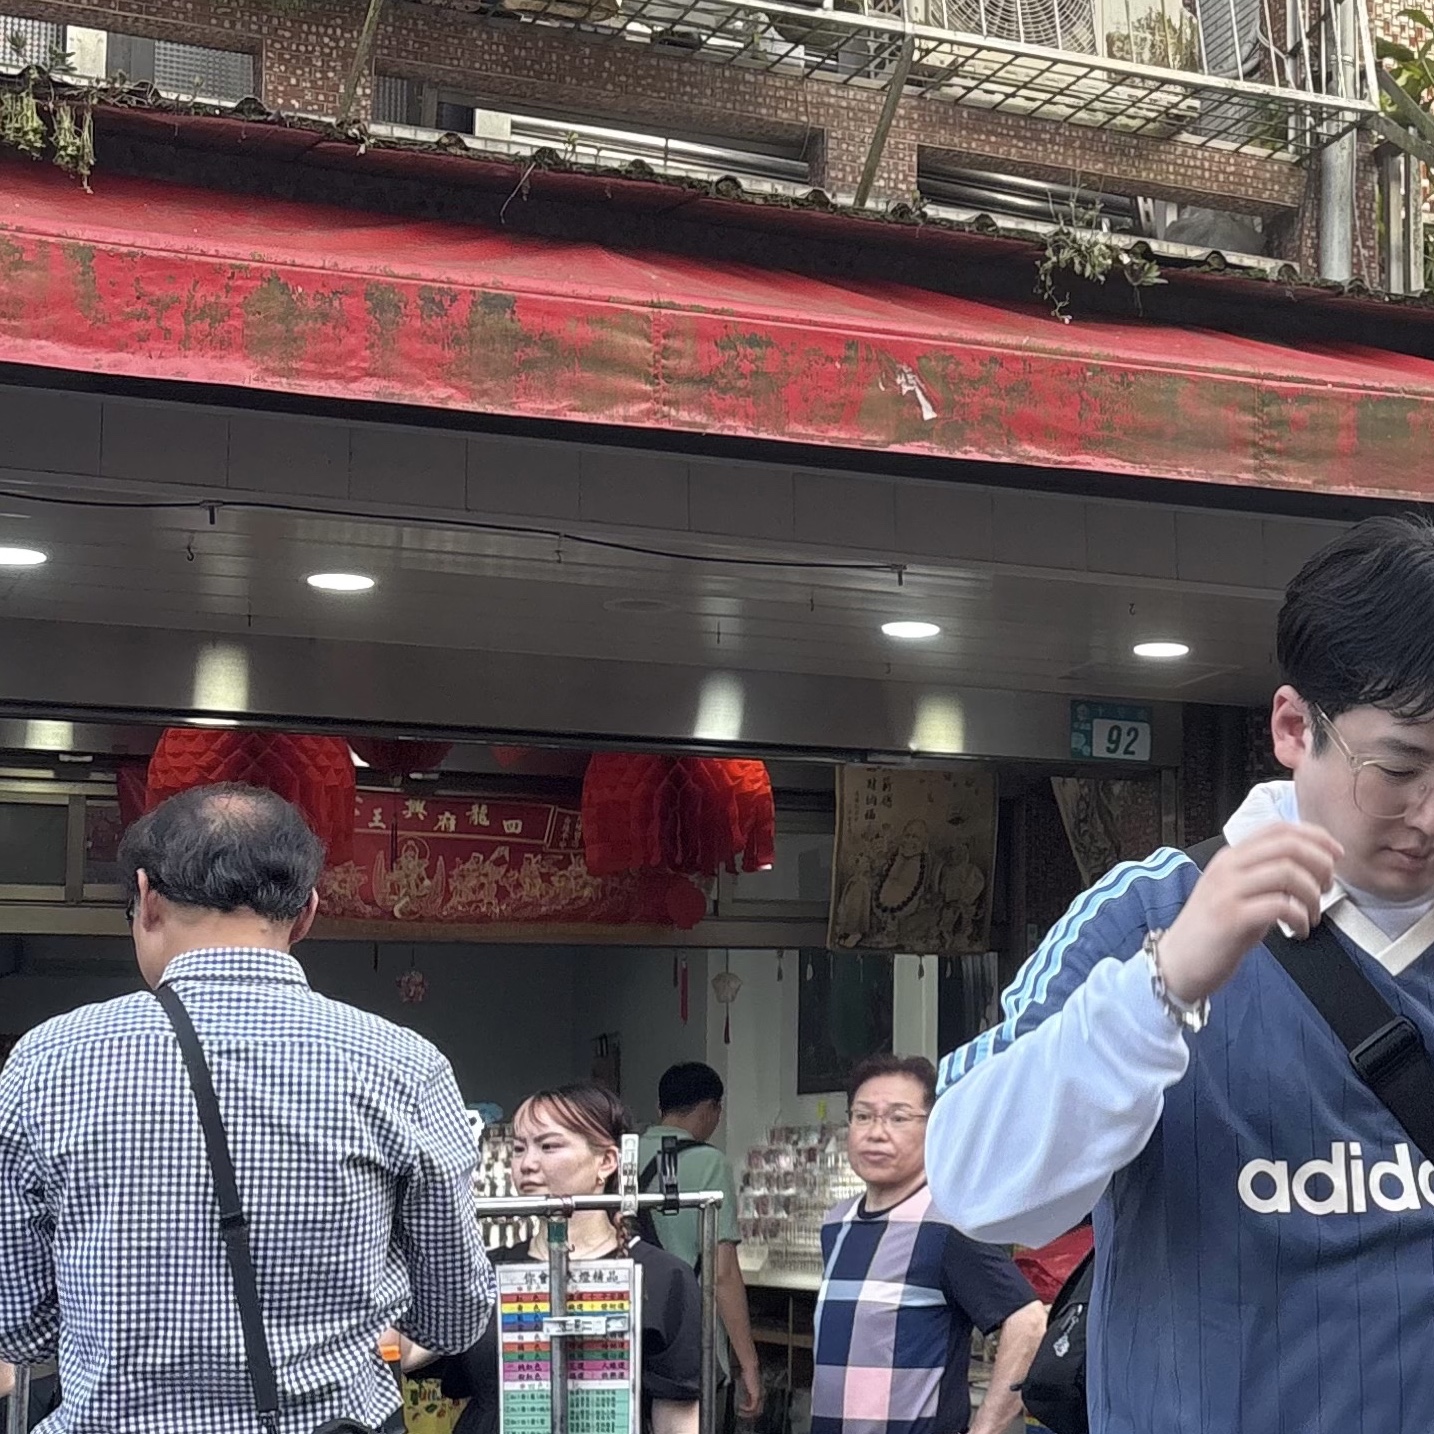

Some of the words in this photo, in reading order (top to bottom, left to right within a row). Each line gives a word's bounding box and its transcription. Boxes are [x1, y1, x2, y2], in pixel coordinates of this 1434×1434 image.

[1106, 724, 1140, 756] 92
[523, 1269, 620, 1284] 你會天燈精品
